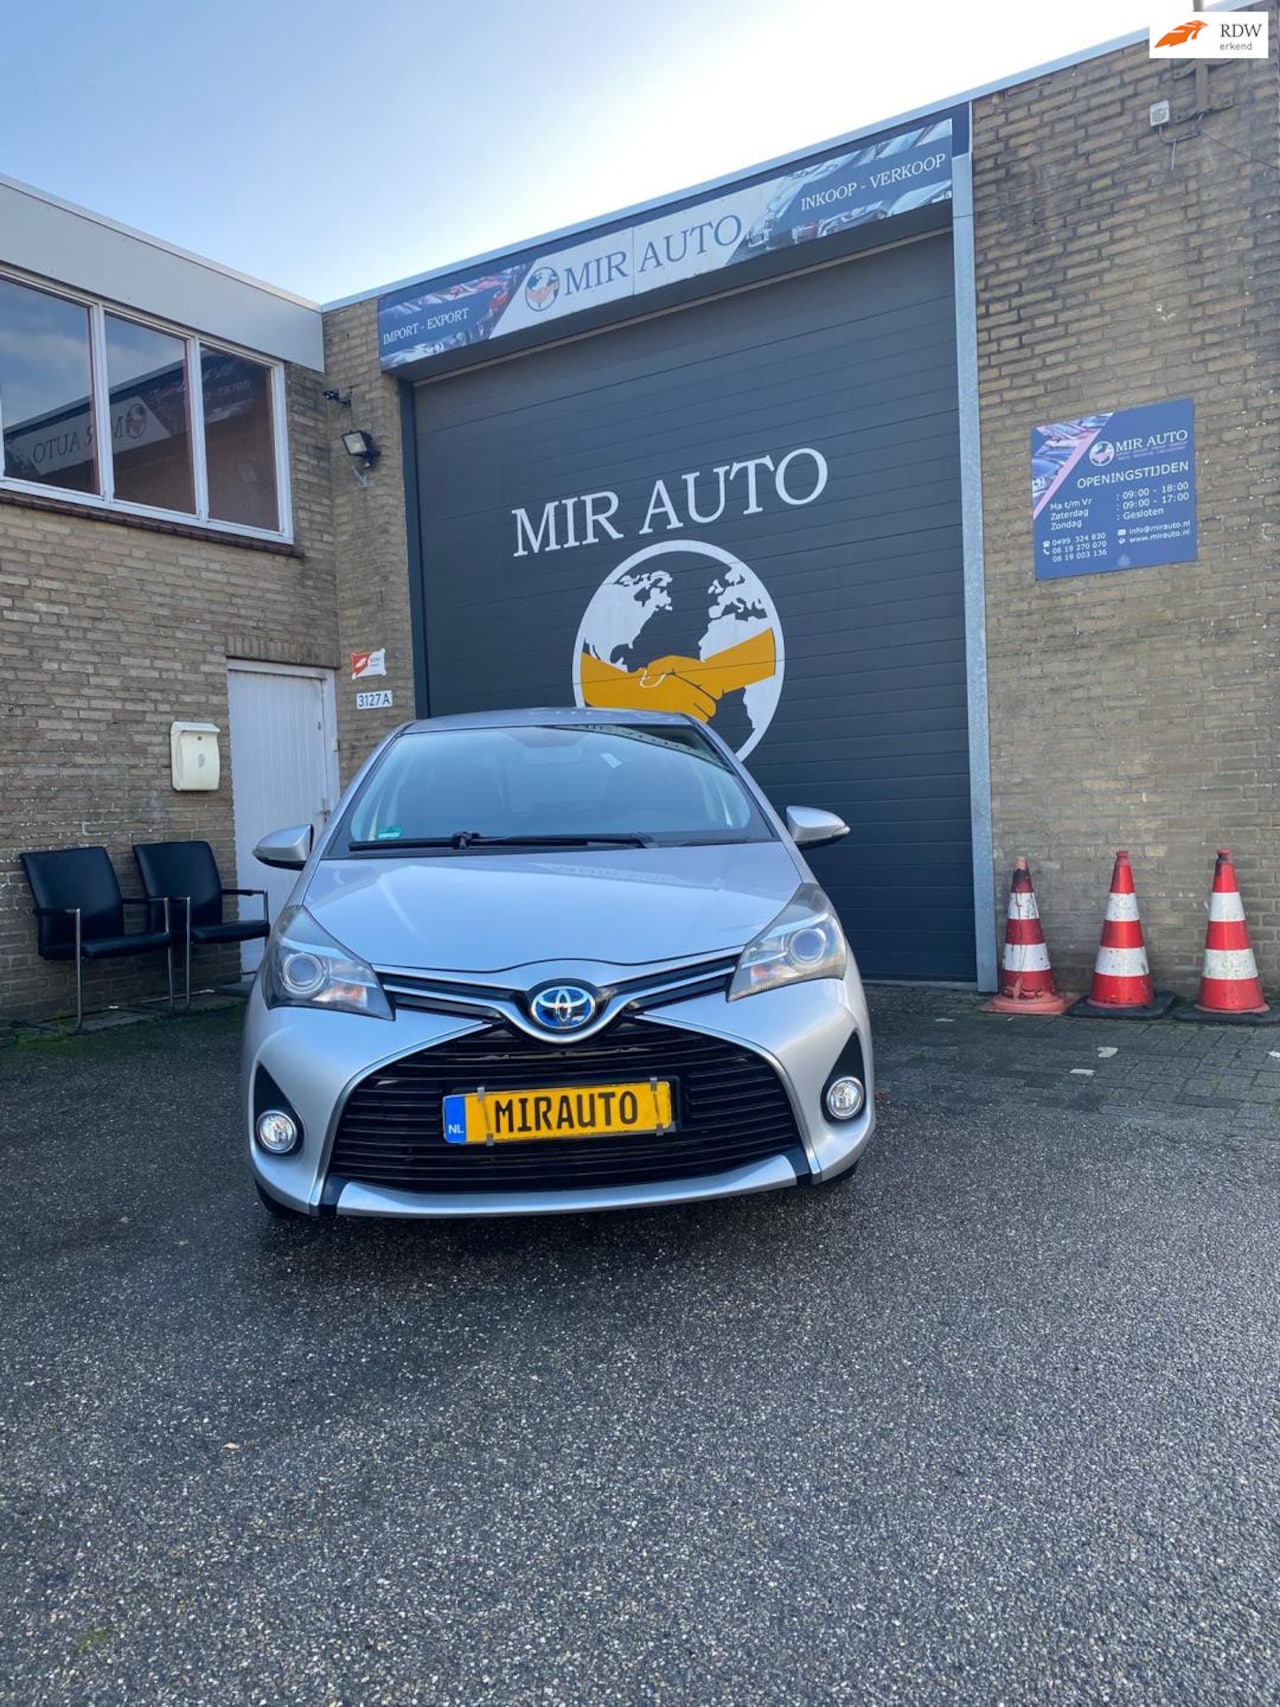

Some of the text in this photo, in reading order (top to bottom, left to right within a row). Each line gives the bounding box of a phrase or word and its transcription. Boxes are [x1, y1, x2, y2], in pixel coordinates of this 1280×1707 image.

[800, 182, 858, 212] INKOOP
[870, 153, 946, 190] VERKOOP
[564, 214, 742, 296] MIR AUTO
[383, 322, 420, 345] IMPORT
[427, 307, 470, 330] EXPORT
[1116, 438, 1142, 452] MIR
[1146, 430, 1188, 447] AUTO
[1077, 460, 1189, 489] OPENINGSTIJDEN
[512, 448, 828, 557] MIR AUTO
[1122, 488, 1150, 500] 09:00
[1162, 481, 1189, 494] 18:00
[1050, 509, 1089, 520] Zaterdag
[1123, 498, 1150, 510] 09:00
[1162, 492, 1189, 504] 17:00
[1050, 520, 1082, 530] Zondag
[1123, 508, 1164, 520] Gesloten
[494, 1090, 638, 1134] MIRAUTO
[448, 1124, 464, 1134] NL
